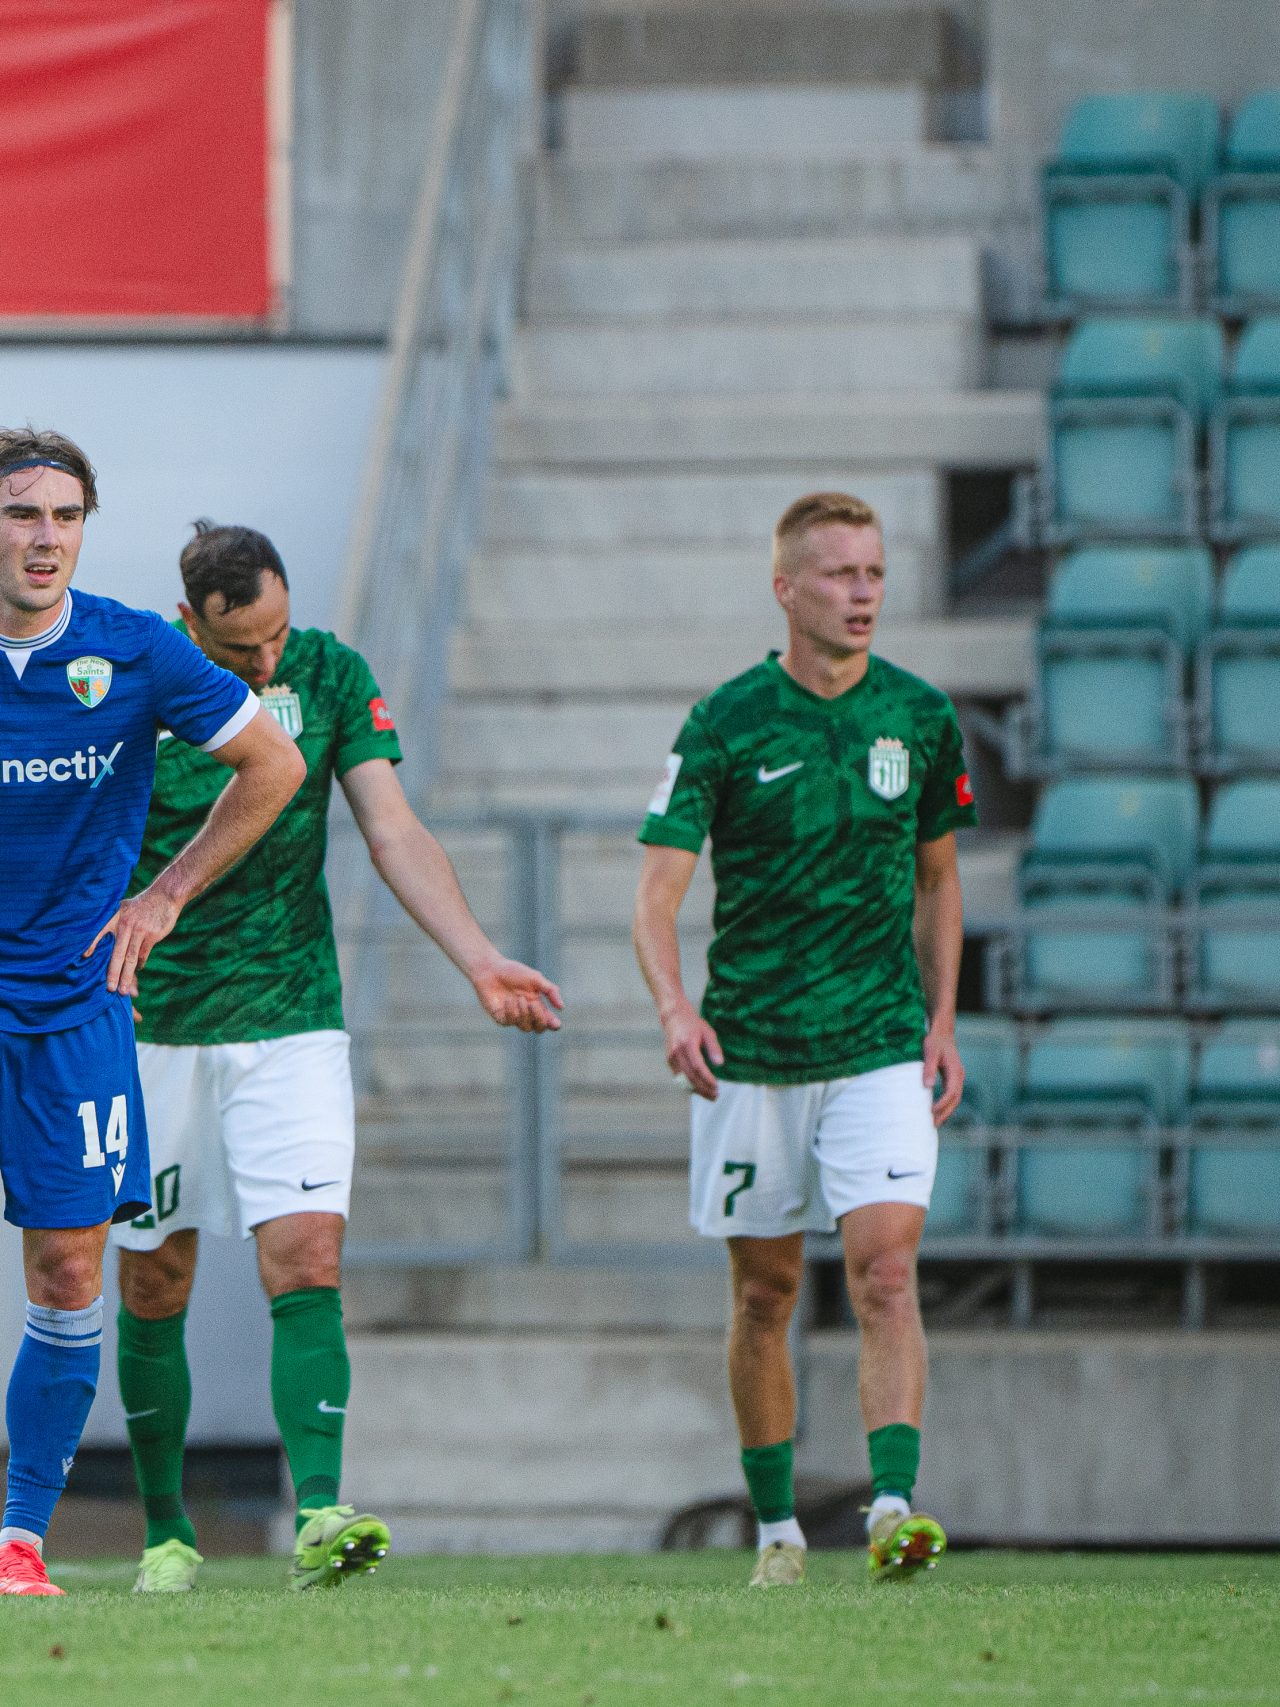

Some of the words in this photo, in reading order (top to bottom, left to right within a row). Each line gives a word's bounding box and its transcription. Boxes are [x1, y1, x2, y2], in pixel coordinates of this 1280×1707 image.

[77, 667, 104, 676] Saints
[77, 1094, 129, 1169] 14
[131, 1163, 182, 1229] 0
[723, 1160, 758, 1217] 7
